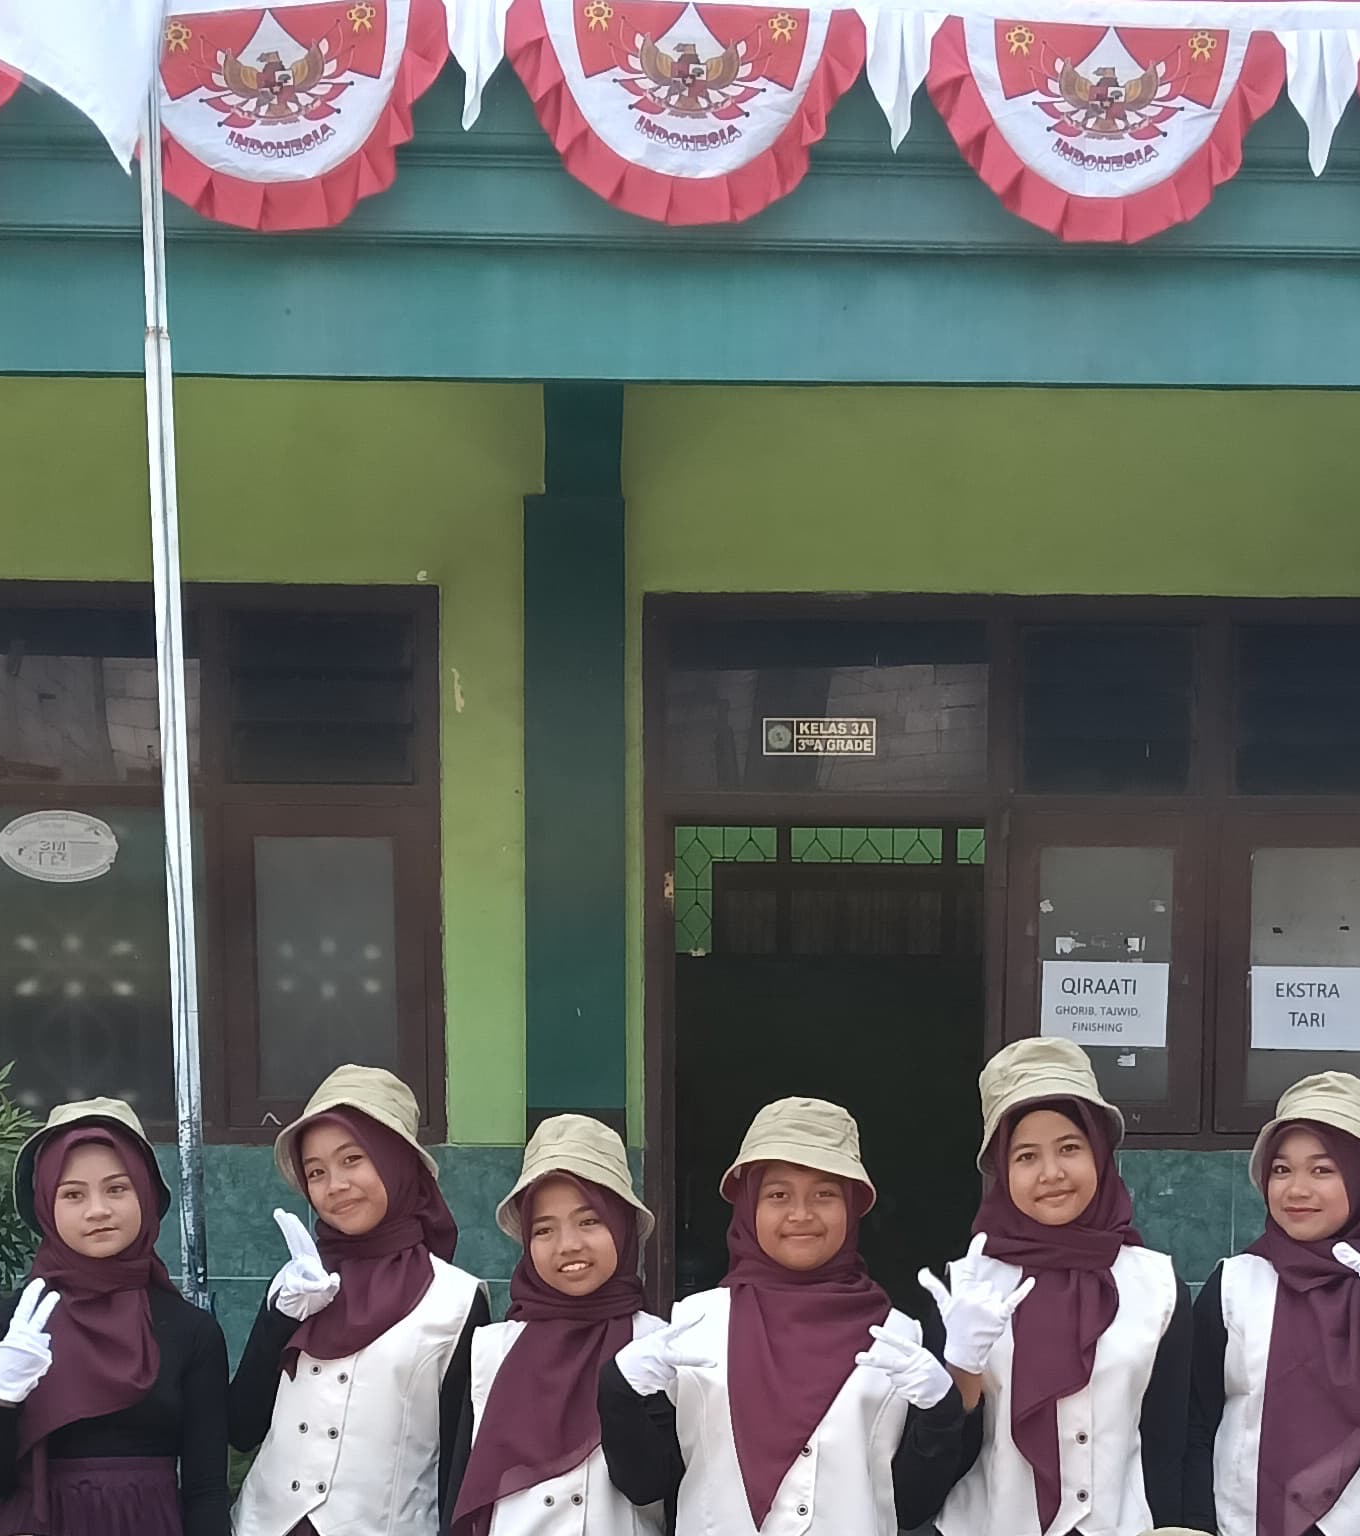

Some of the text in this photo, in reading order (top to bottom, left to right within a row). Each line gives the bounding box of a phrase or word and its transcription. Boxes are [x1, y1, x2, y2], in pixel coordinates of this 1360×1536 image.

[226, 123, 336, 158] INDONESIA
[635, 115, 742, 151] INDONESIA
[1052, 137, 1159, 172] INDONESIA
[799, 722, 870, 735] KELAS 3A
[826, 739, 872, 751] GRADE
[1061, 977, 1137, 995] QIRAATI
[1275, 982, 1340, 998] EKSTRA
[1071, 1021, 1123, 1033] FINISHING
[1287, 1011, 1325, 1028] TARI
